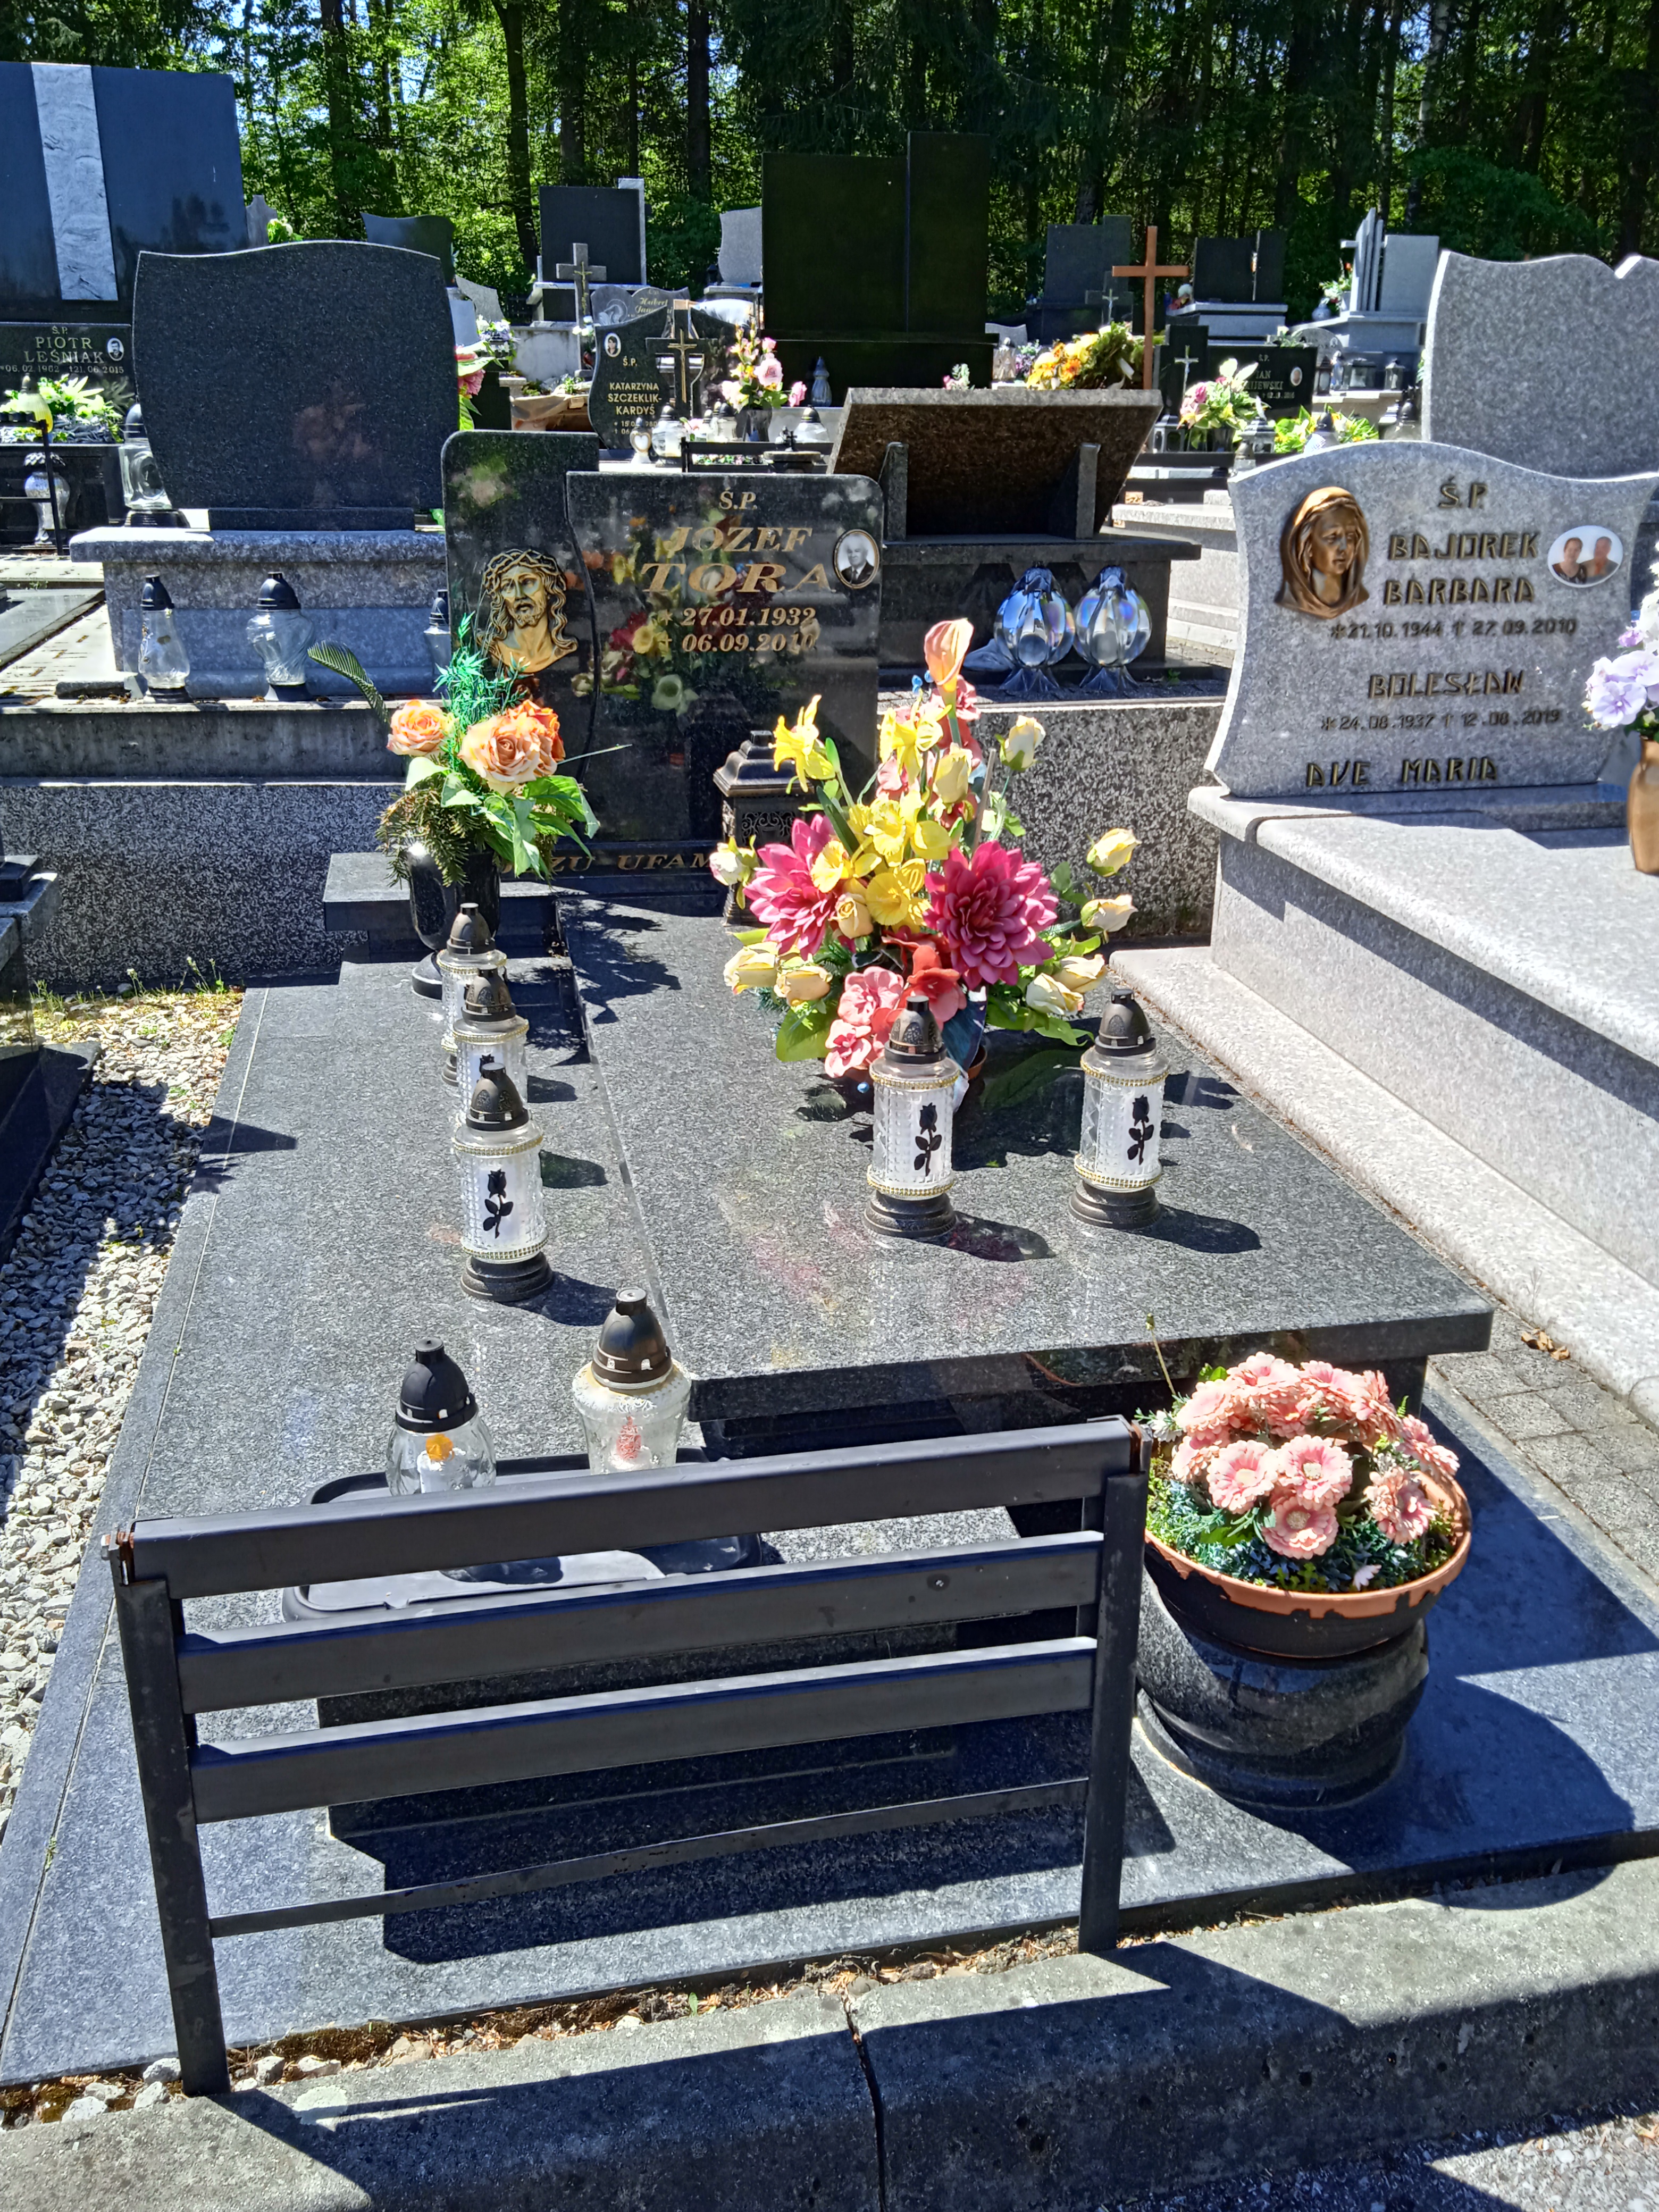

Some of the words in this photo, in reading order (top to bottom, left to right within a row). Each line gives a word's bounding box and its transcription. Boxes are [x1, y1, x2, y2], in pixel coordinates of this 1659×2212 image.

[35, 336, 93, 349] PIOTR
[24, 349, 105, 364] LEŚNIAK
[623, 355, 638, 367] Ś.P.
[608, 393, 663, 403] SZCZEKLIK-
[609, 382, 660, 391] KATARZYNA
[616, 404, 656, 415] KARDYŚ
[719, 488, 758, 510] Ś.P.
[1438, 476, 1488, 509] Ś.P.
[663, 526, 813, 553] JOZEF
[1388, 532, 1540, 559] BAJOREK
[640, 562, 836, 593] TORA
[1384, 576, 1535, 605] BARBARA
[1368, 669, 1525, 699] BOLESŁAW
[1306, 760, 1372, 787] AVE
[1401, 756, 1498, 784] MARIA
